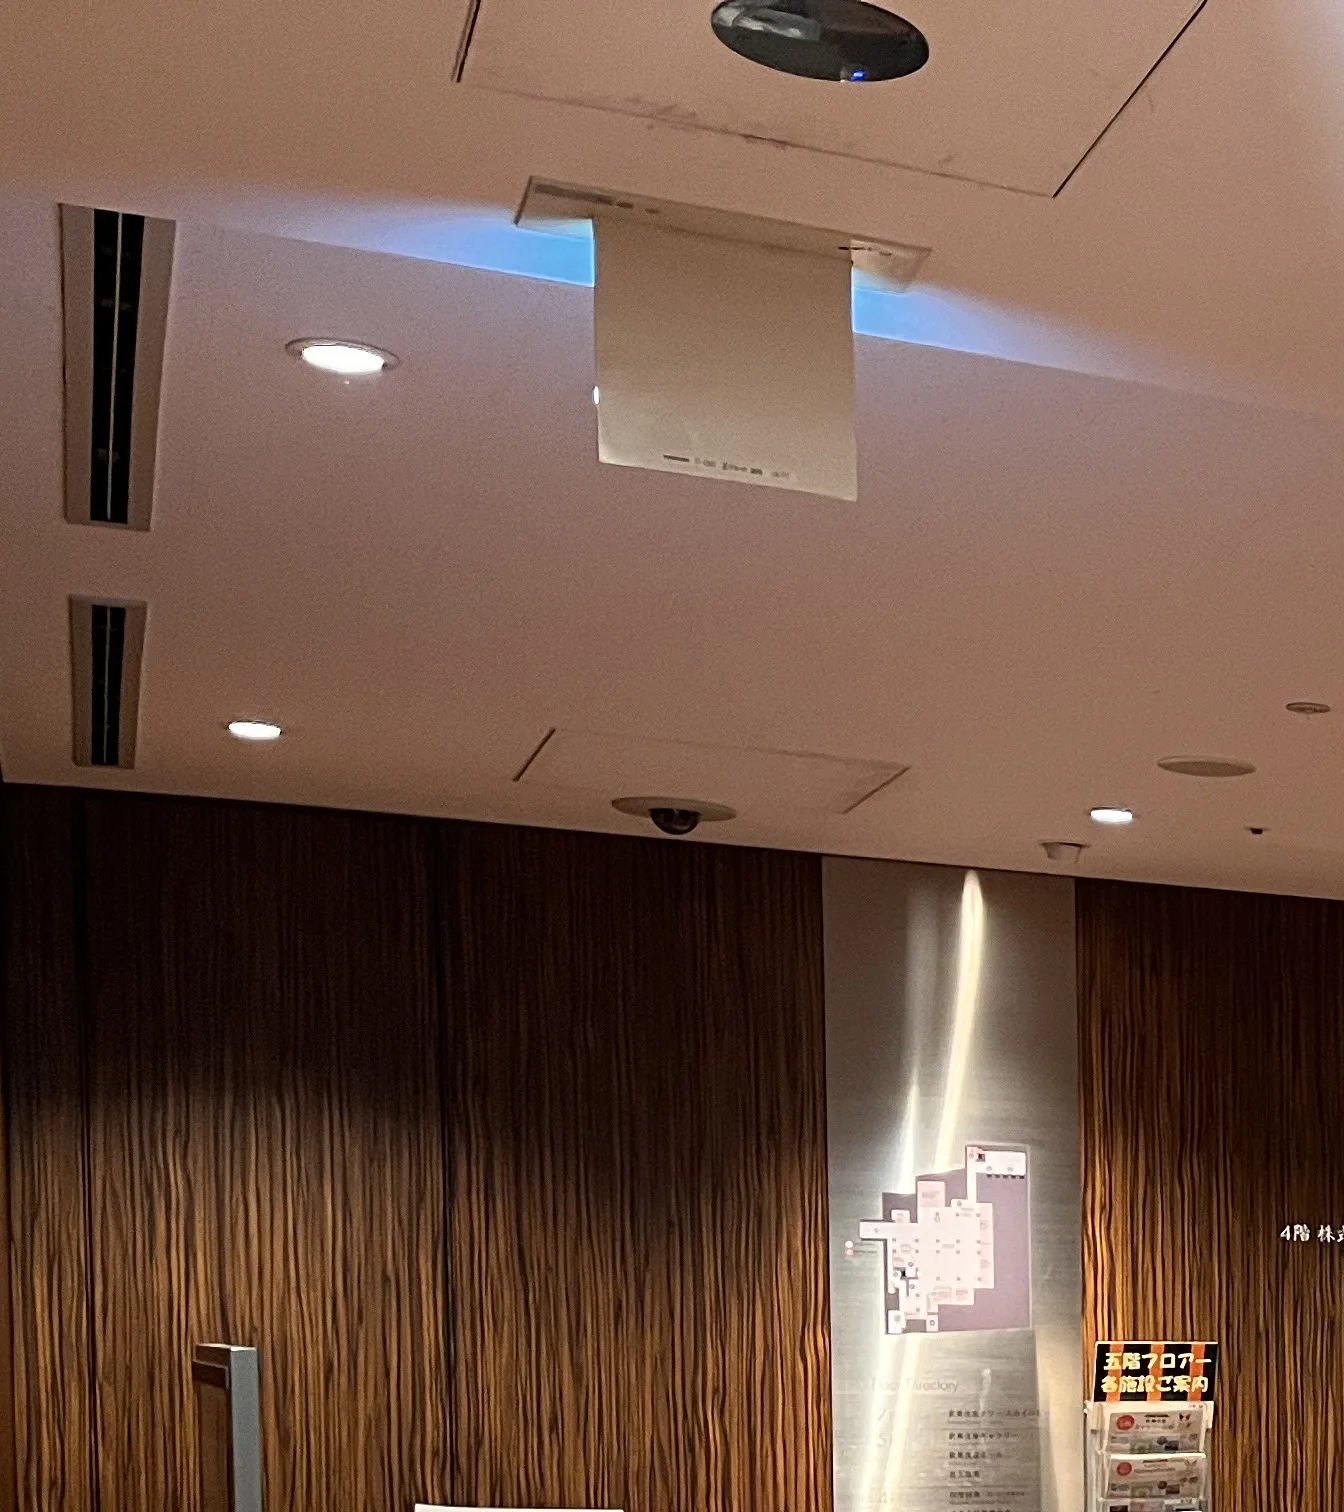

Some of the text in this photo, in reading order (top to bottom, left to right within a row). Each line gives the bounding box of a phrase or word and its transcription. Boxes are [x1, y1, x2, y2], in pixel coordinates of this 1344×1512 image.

[1279, 1223, 1311, 1242] 4階
[1103, 1352, 1212, 1371] 五階フロアー
[1101, 1375, 1209, 1393] 各施設ご案内
